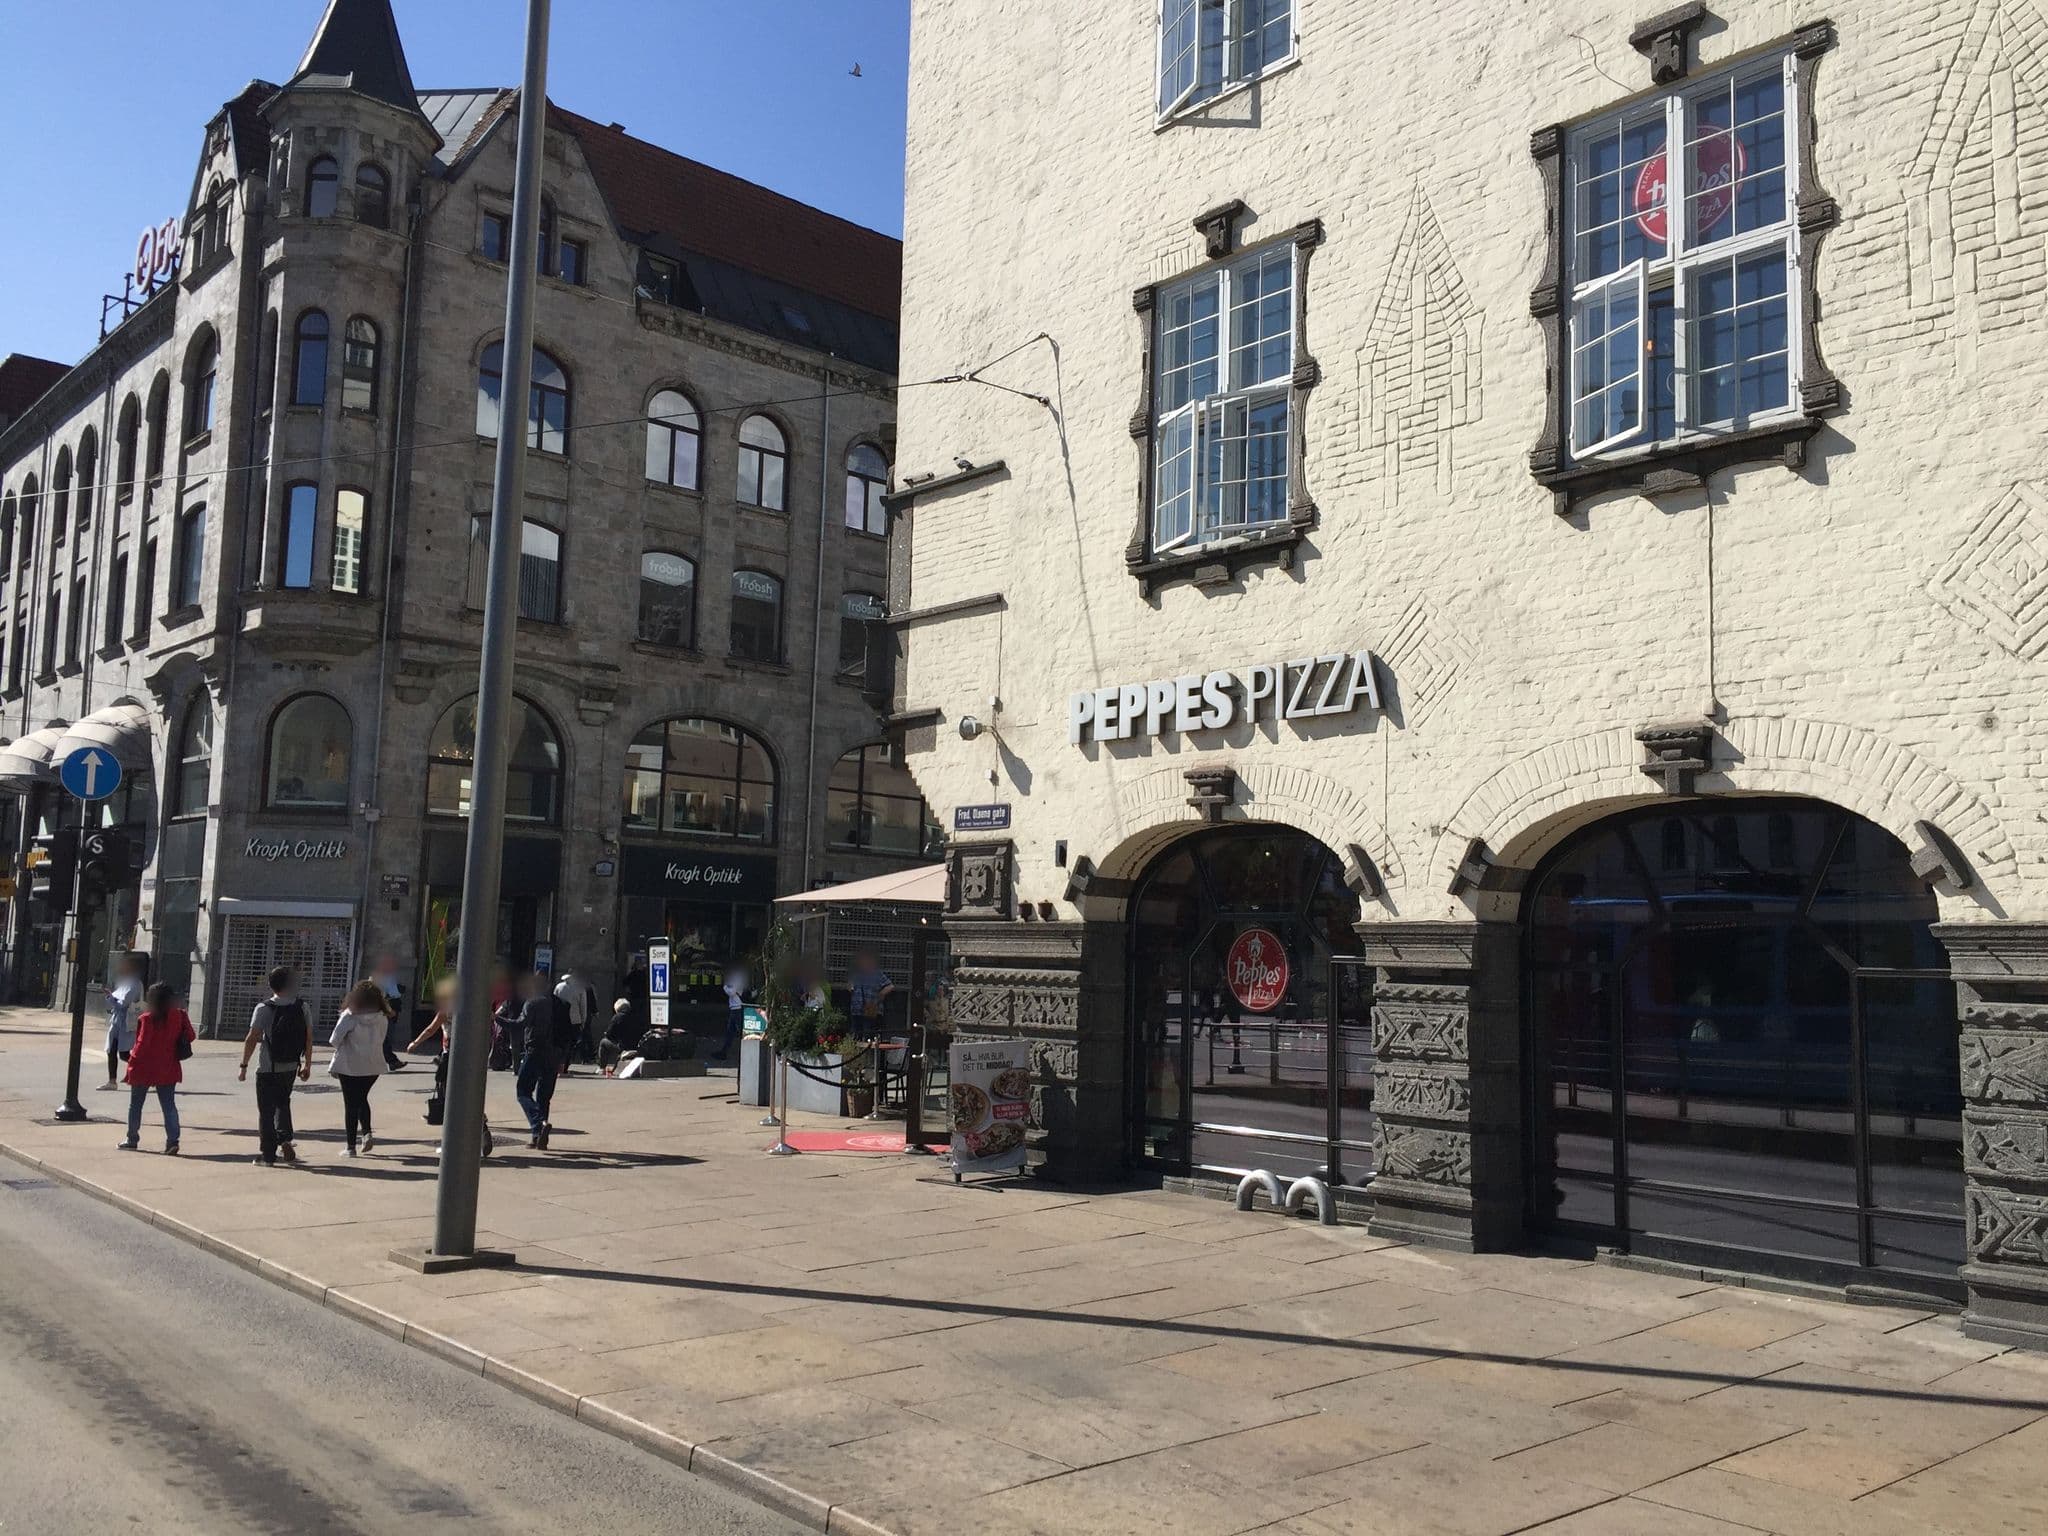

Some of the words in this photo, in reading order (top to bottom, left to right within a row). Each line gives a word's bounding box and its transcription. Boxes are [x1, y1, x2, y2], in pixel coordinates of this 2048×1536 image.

[1070, 670, 1234, 744] PEPPES
[1247, 649, 1381, 724] PIZZA
[992, 807, 1006, 821] gate
[244, 838, 289, 862] Krogh
[294, 839, 346, 862] Optikk
[664, 862, 701, 885] Krogh
[703, 865, 744, 886] Optikk
[1233, 956, 1281, 988] Peppes
[963, 1063, 975, 1071] DET
[976, 1062, 985, 1071] TIL
